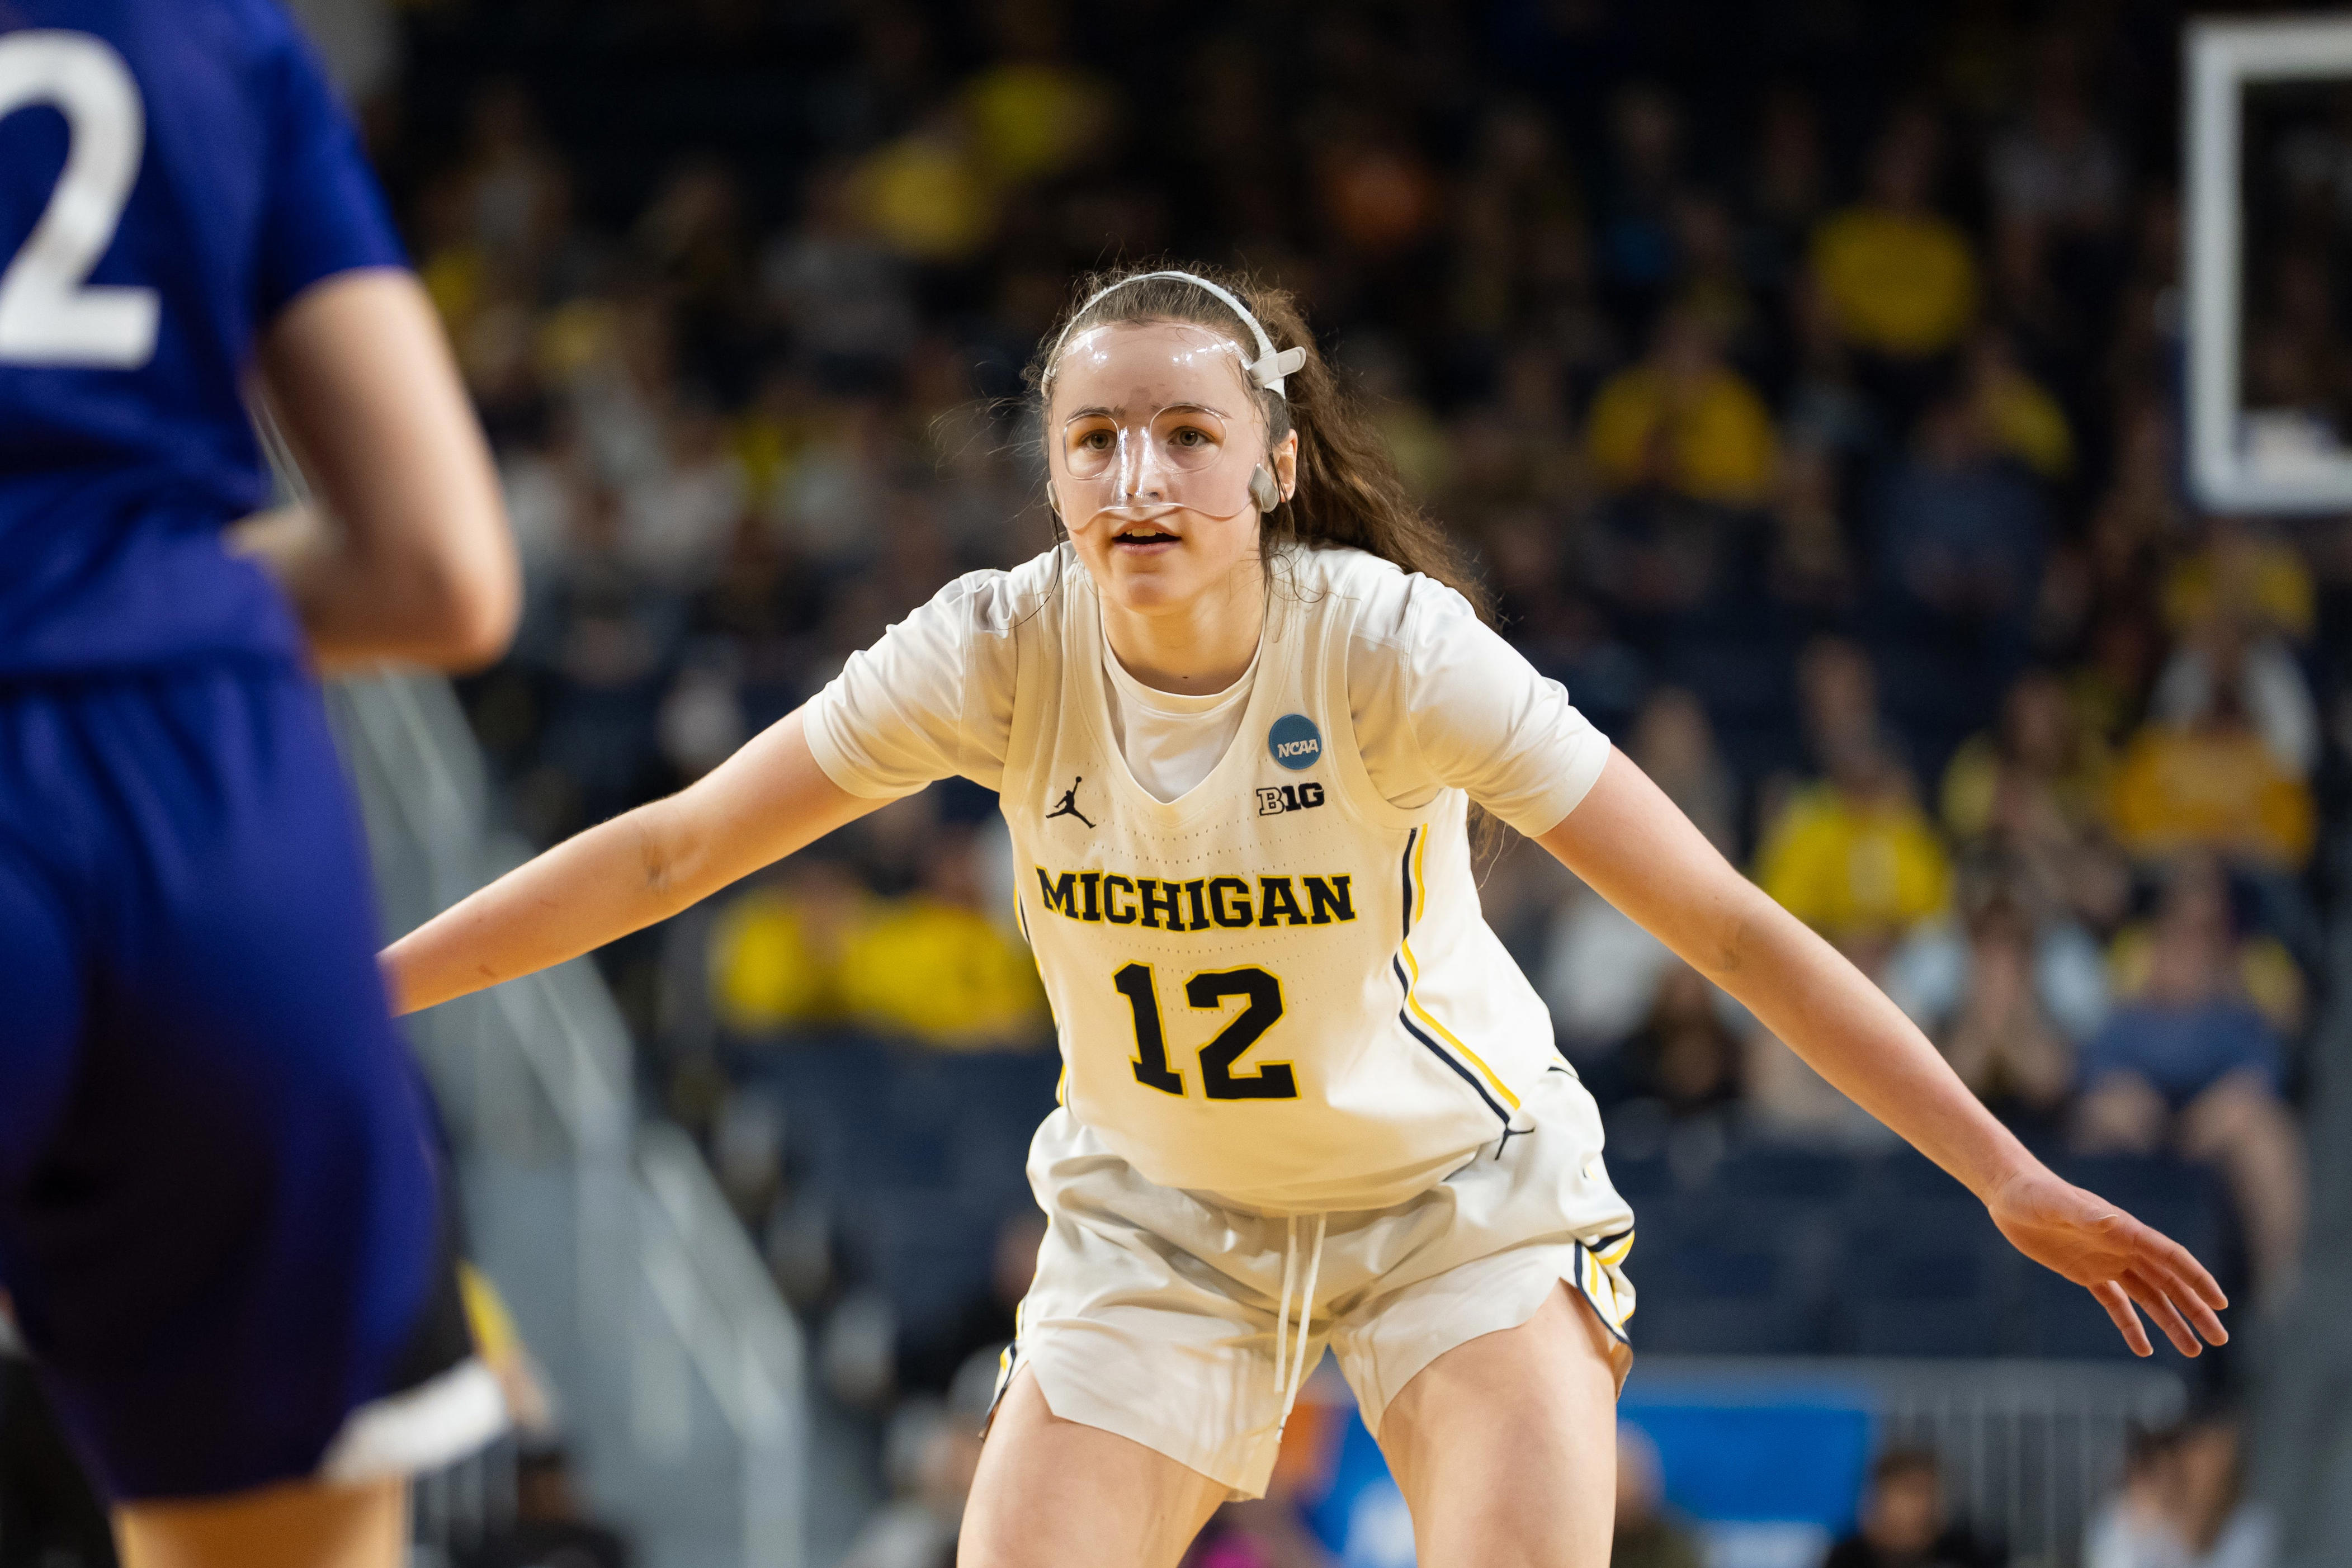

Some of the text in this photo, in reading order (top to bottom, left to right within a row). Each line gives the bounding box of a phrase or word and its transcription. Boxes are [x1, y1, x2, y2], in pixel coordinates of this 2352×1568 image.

[0, 28, 162, 371] 2
[1277, 739, 1319, 758] NCAA
[1035, 865, 1357, 932] MICHIGAN
[1112, 960, 1301, 1102] 12
